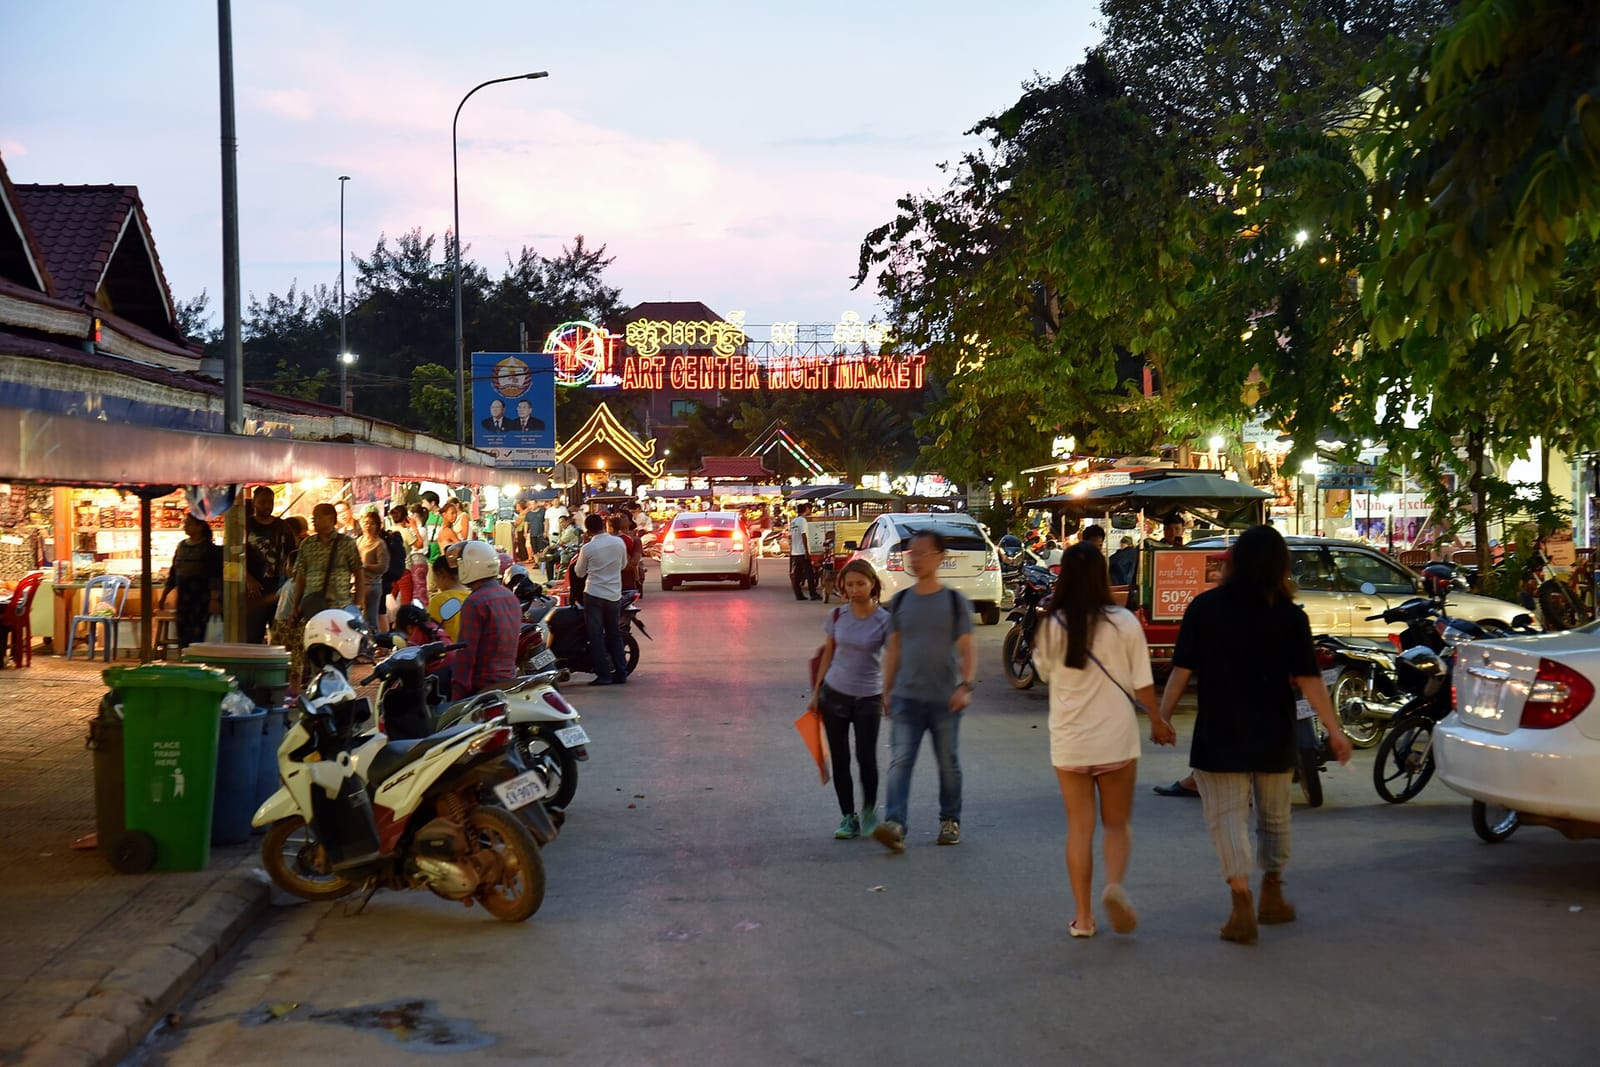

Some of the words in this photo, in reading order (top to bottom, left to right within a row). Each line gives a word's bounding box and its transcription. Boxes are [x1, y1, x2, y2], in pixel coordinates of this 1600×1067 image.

[623, 356, 666, 390] ART
[670, 356, 760, 390] CENTER
[768, 356, 833, 390] NIGHT
[834, 355, 926, 390] MARKET
[1161, 590, 1194, 603] 50%
[1167, 603, 1188, 612] OFF
